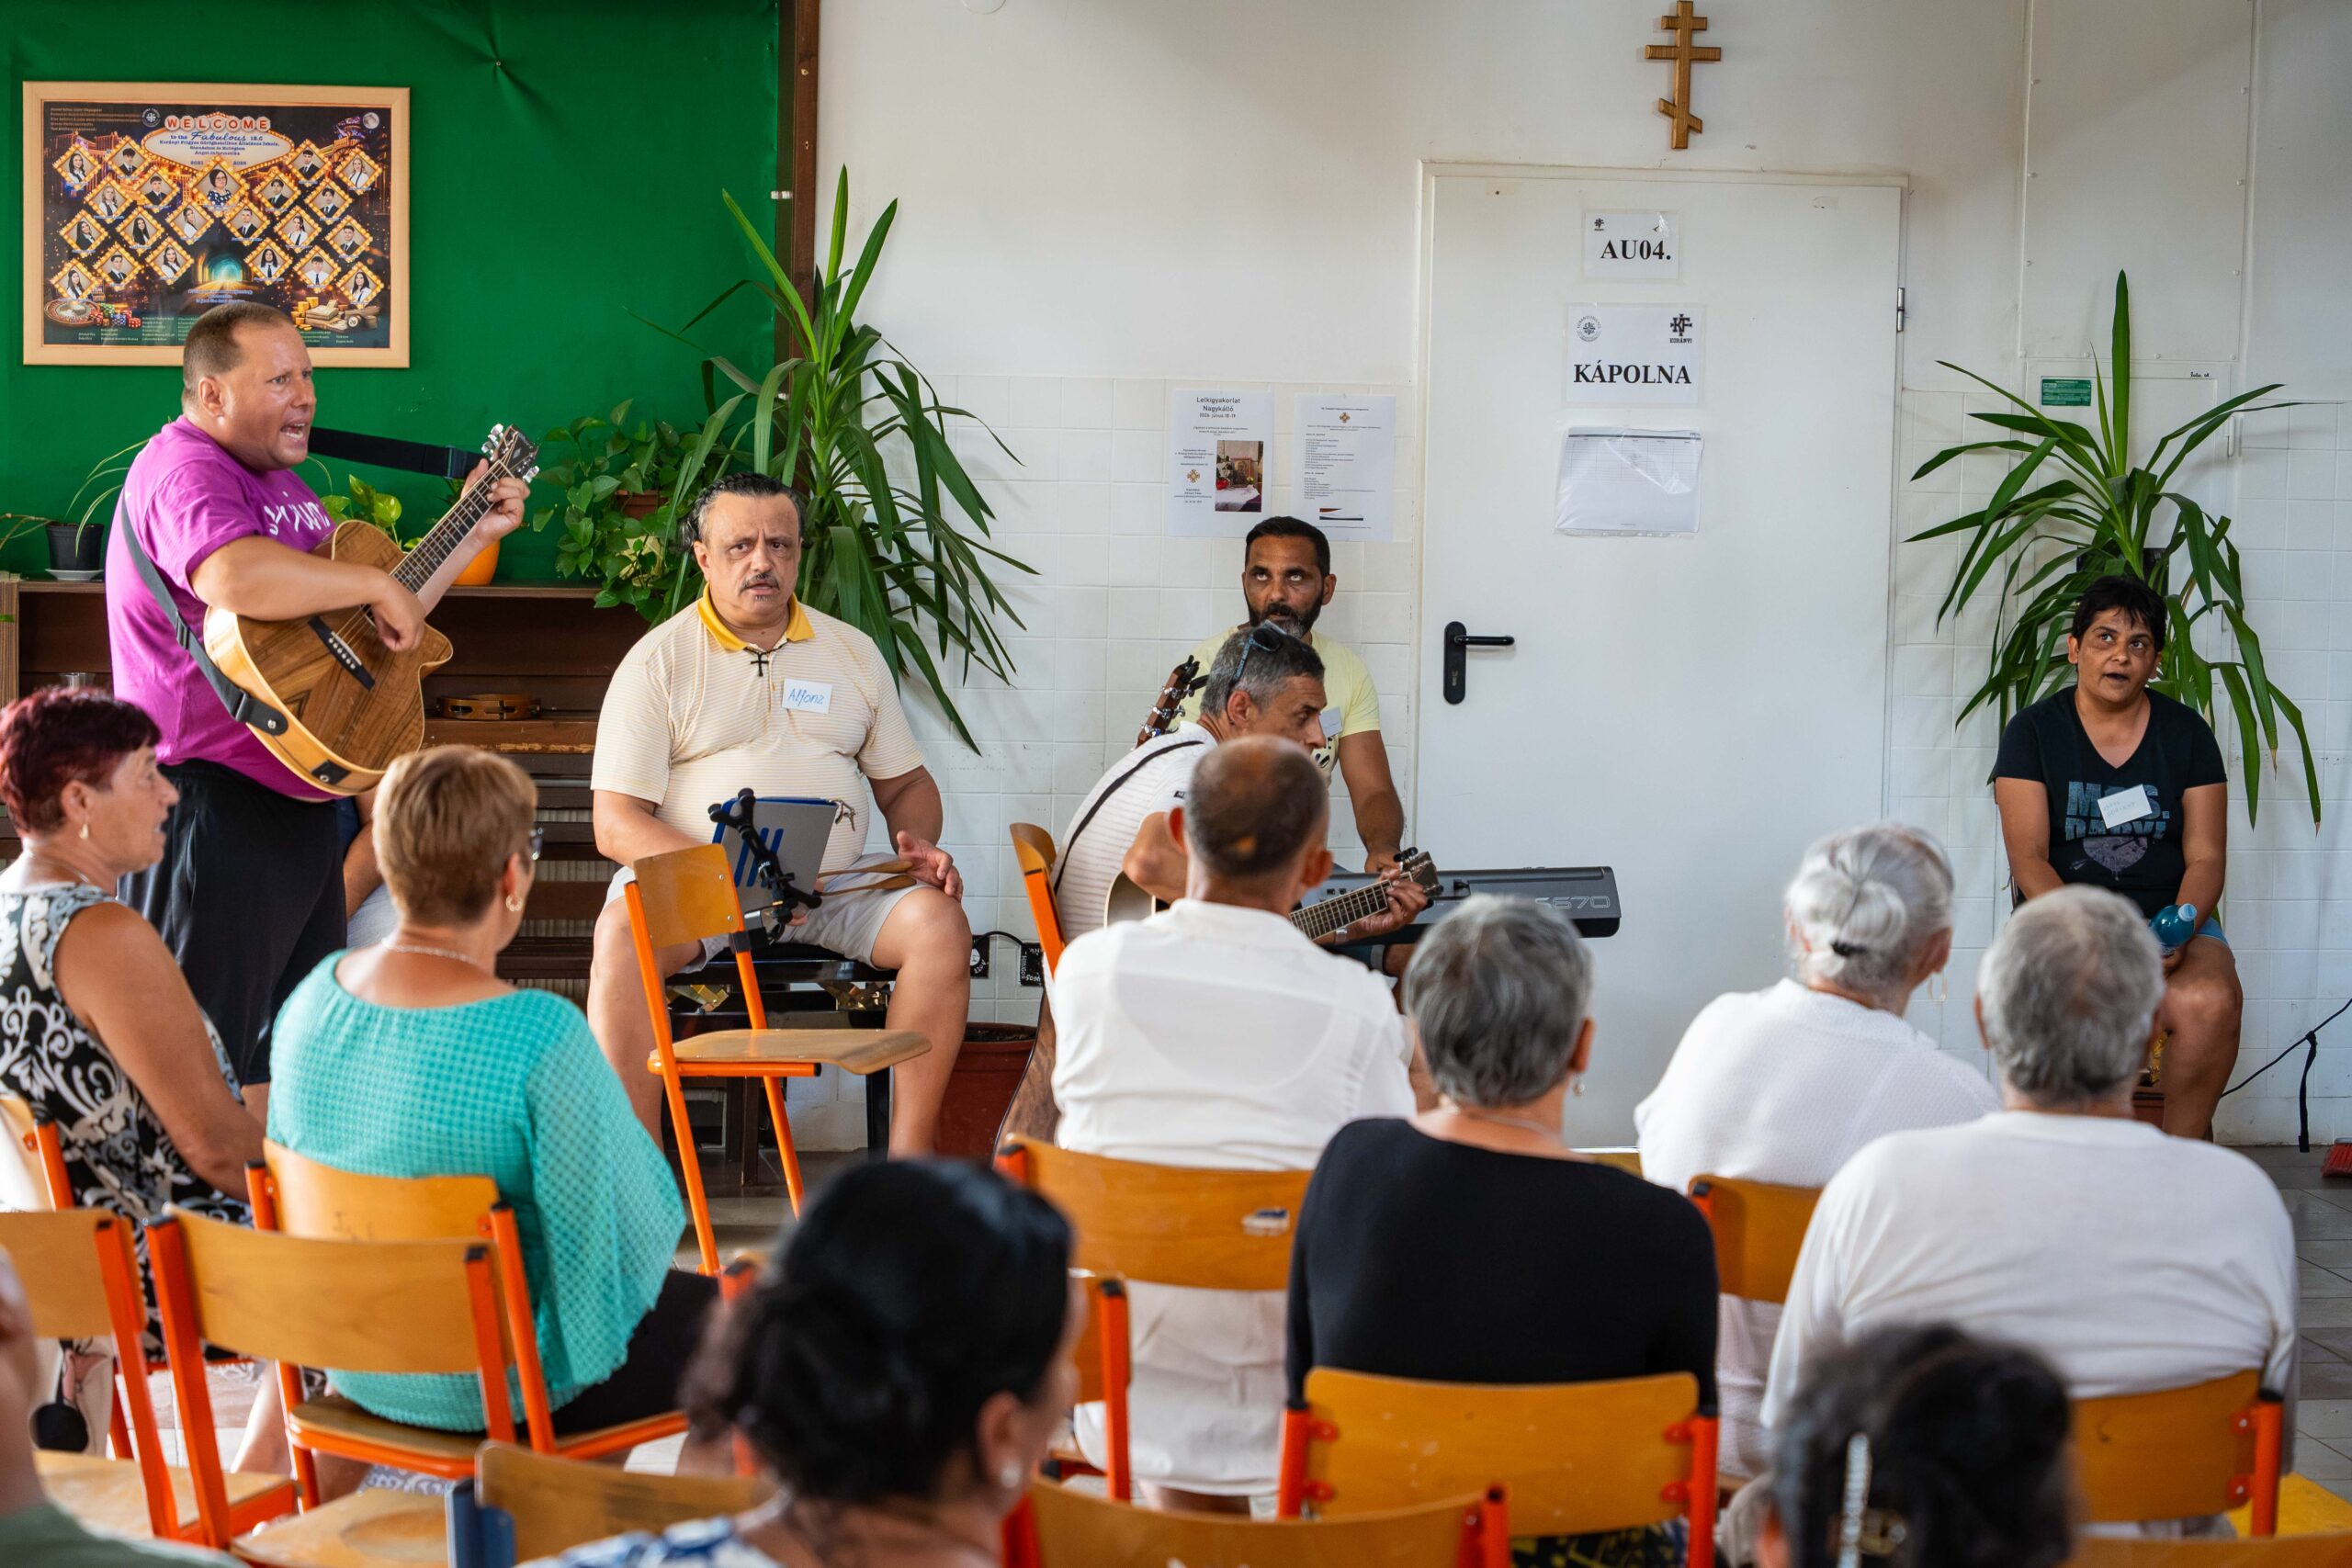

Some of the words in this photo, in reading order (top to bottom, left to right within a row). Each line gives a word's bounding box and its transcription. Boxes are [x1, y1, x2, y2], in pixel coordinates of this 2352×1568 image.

[167, 118, 267, 129] WELCOME
[190, 131, 246, 141] Fabulous
[1600, 240, 1671, 260] AU04.
[1574, 359, 1691, 384] KÁPOLNA
